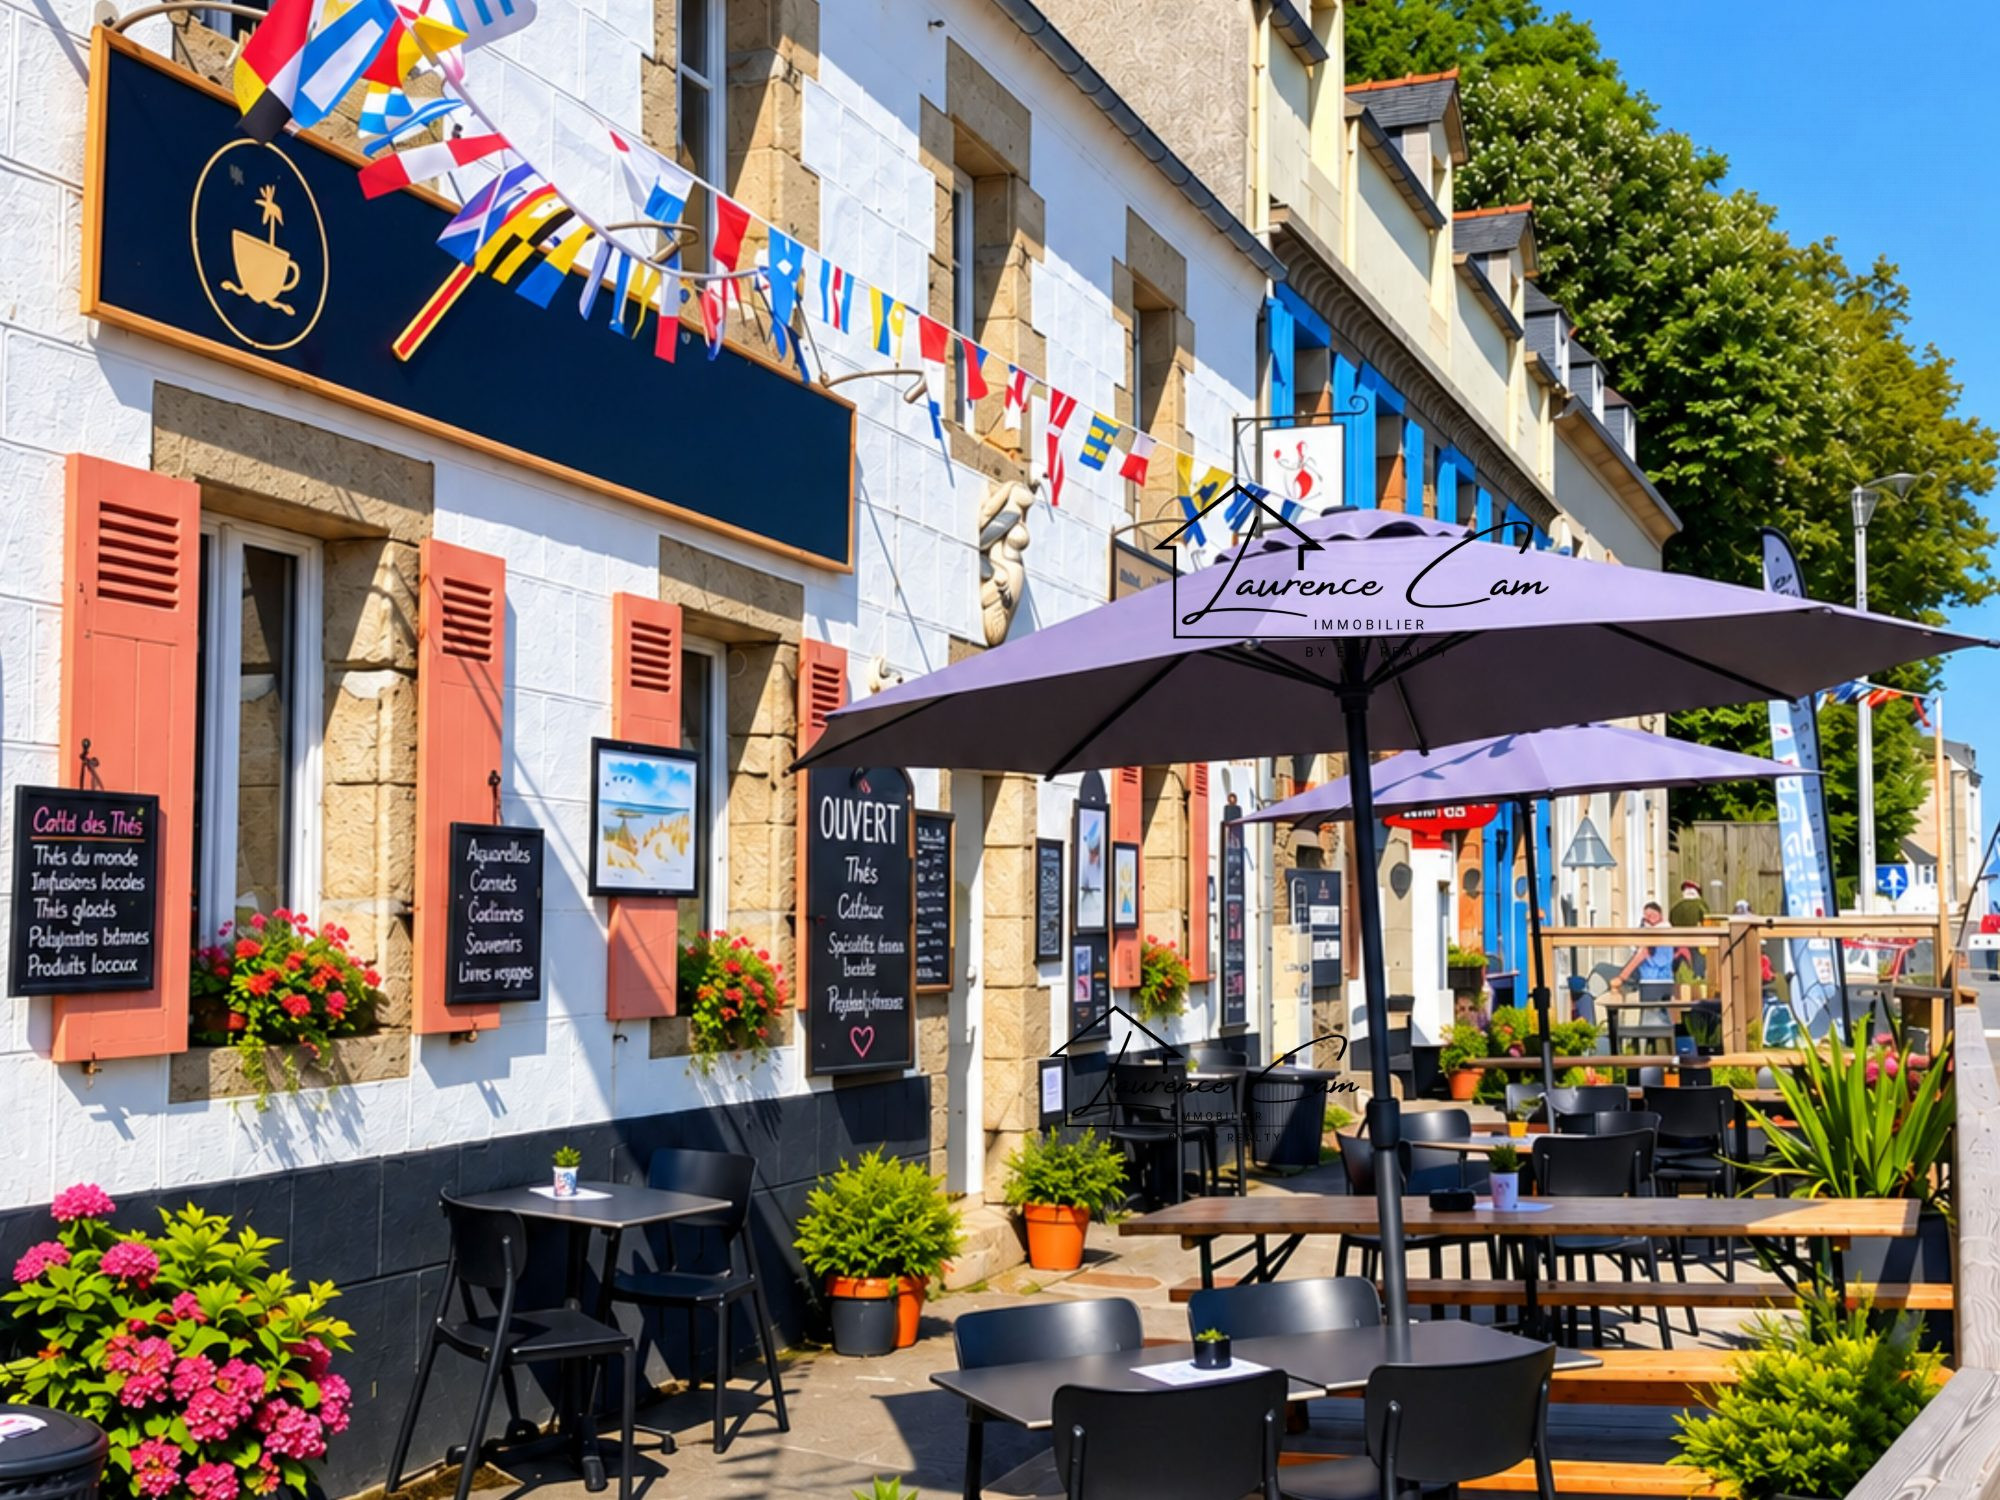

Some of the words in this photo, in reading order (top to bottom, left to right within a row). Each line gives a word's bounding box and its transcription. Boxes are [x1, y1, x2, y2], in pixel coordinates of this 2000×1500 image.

[81, 809, 107, 835] des
[819, 795, 901, 845] OUVERT
[71, 846, 90, 866] du
[93, 848, 139, 867] monde
[844, 855, 879, 885] Thés
[27, 953, 87, 977] Produits
